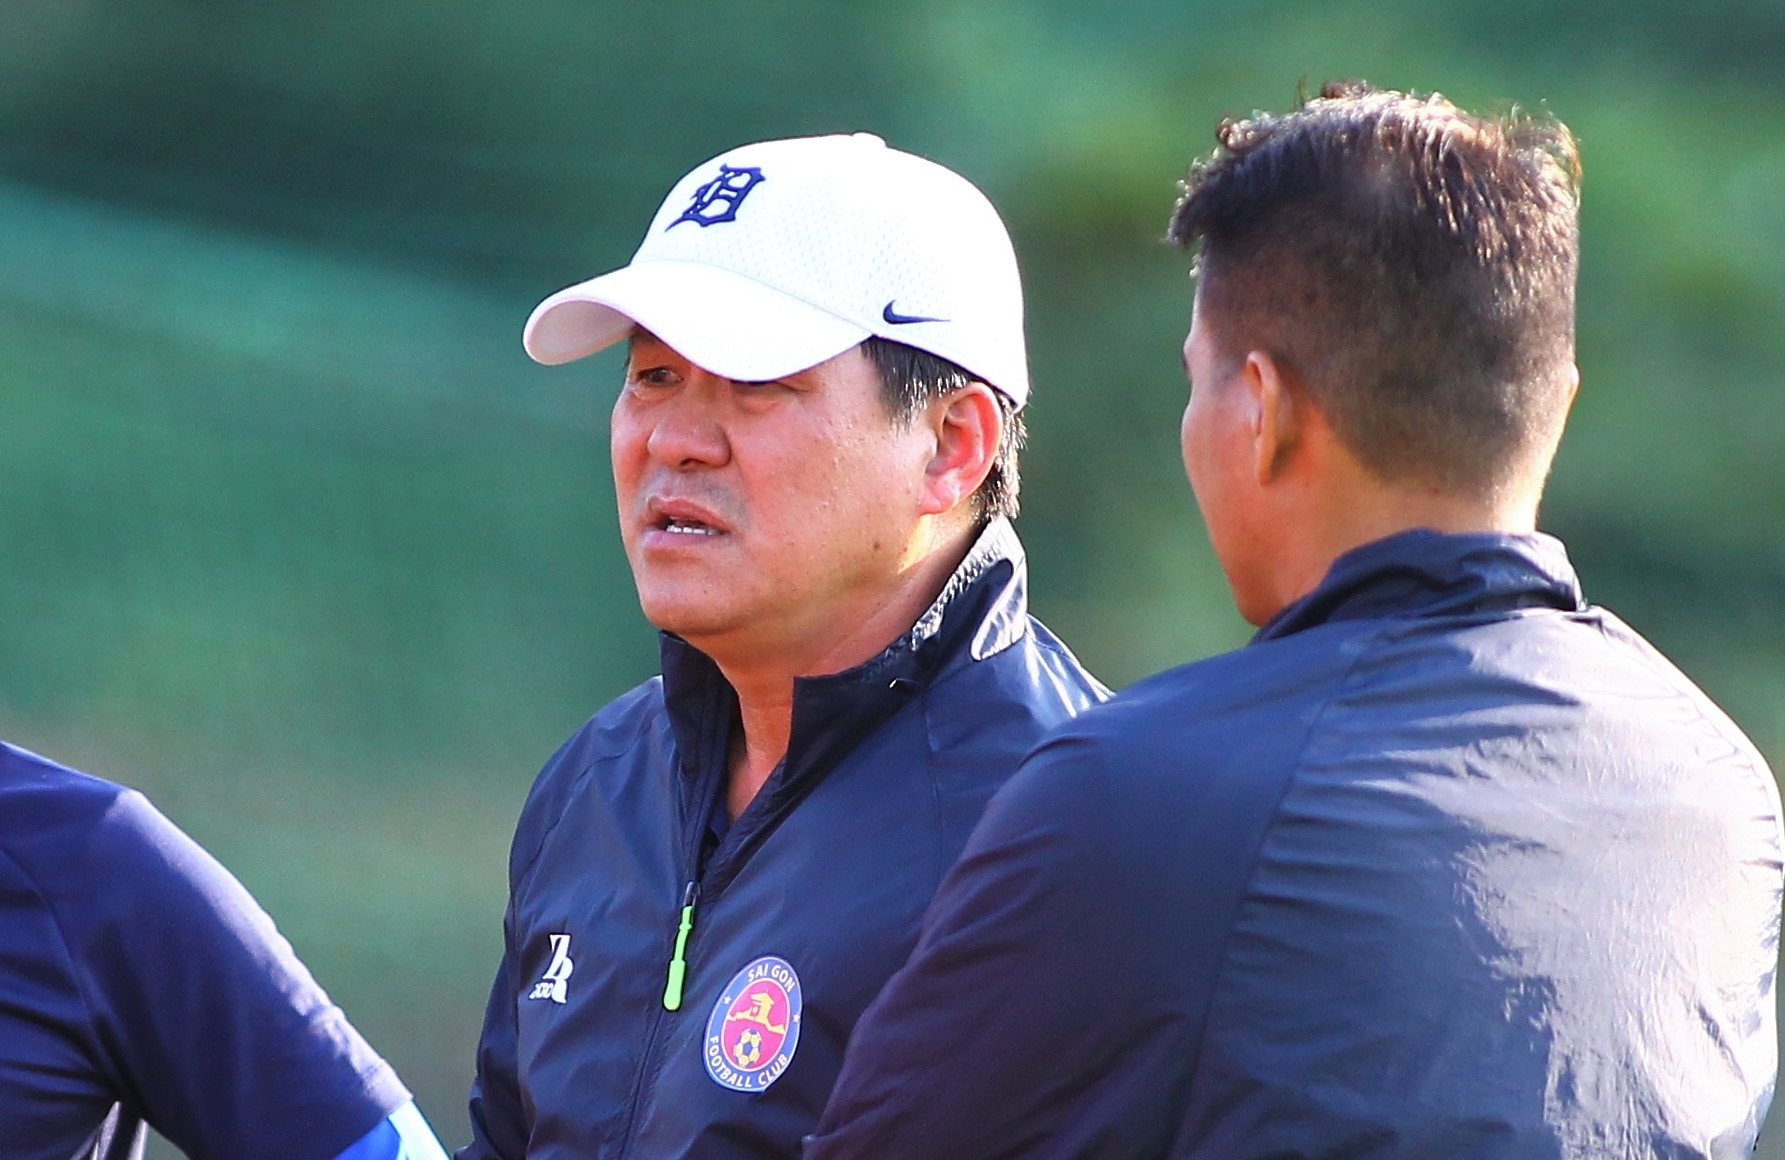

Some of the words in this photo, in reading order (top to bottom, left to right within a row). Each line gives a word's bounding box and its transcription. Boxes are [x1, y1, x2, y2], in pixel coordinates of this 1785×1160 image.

[748, 963, 769, 982] SAI
[771, 964, 796, 993] GON
[709, 1034, 753, 1088] FOOTBALL
[757, 1053, 789, 1085] CLUB
